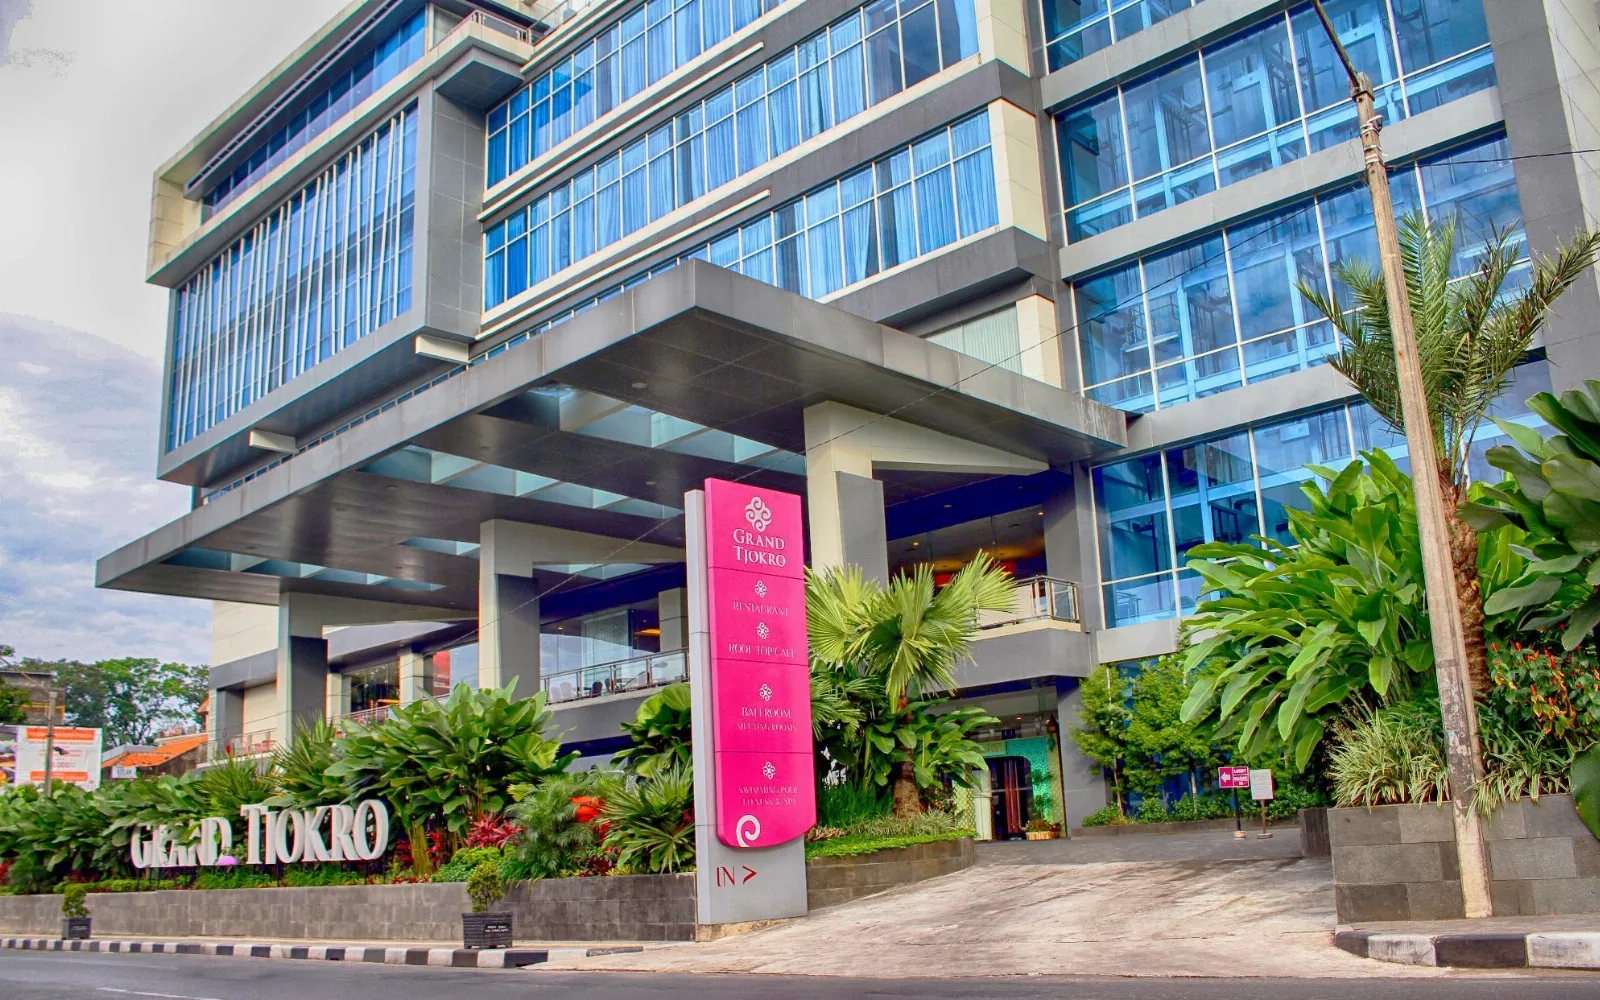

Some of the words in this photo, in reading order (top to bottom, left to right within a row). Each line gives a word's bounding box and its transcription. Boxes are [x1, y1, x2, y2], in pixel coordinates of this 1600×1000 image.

[733, 529, 785, 550] GRAND
[733, 546, 787, 568] TJOKRO
[733, 601, 789, 617] RESTAURANT
[755, 645, 773, 656] TOP
[240, 799, 390, 866] TJOKRO
[716, 866, 735, 887] IN
